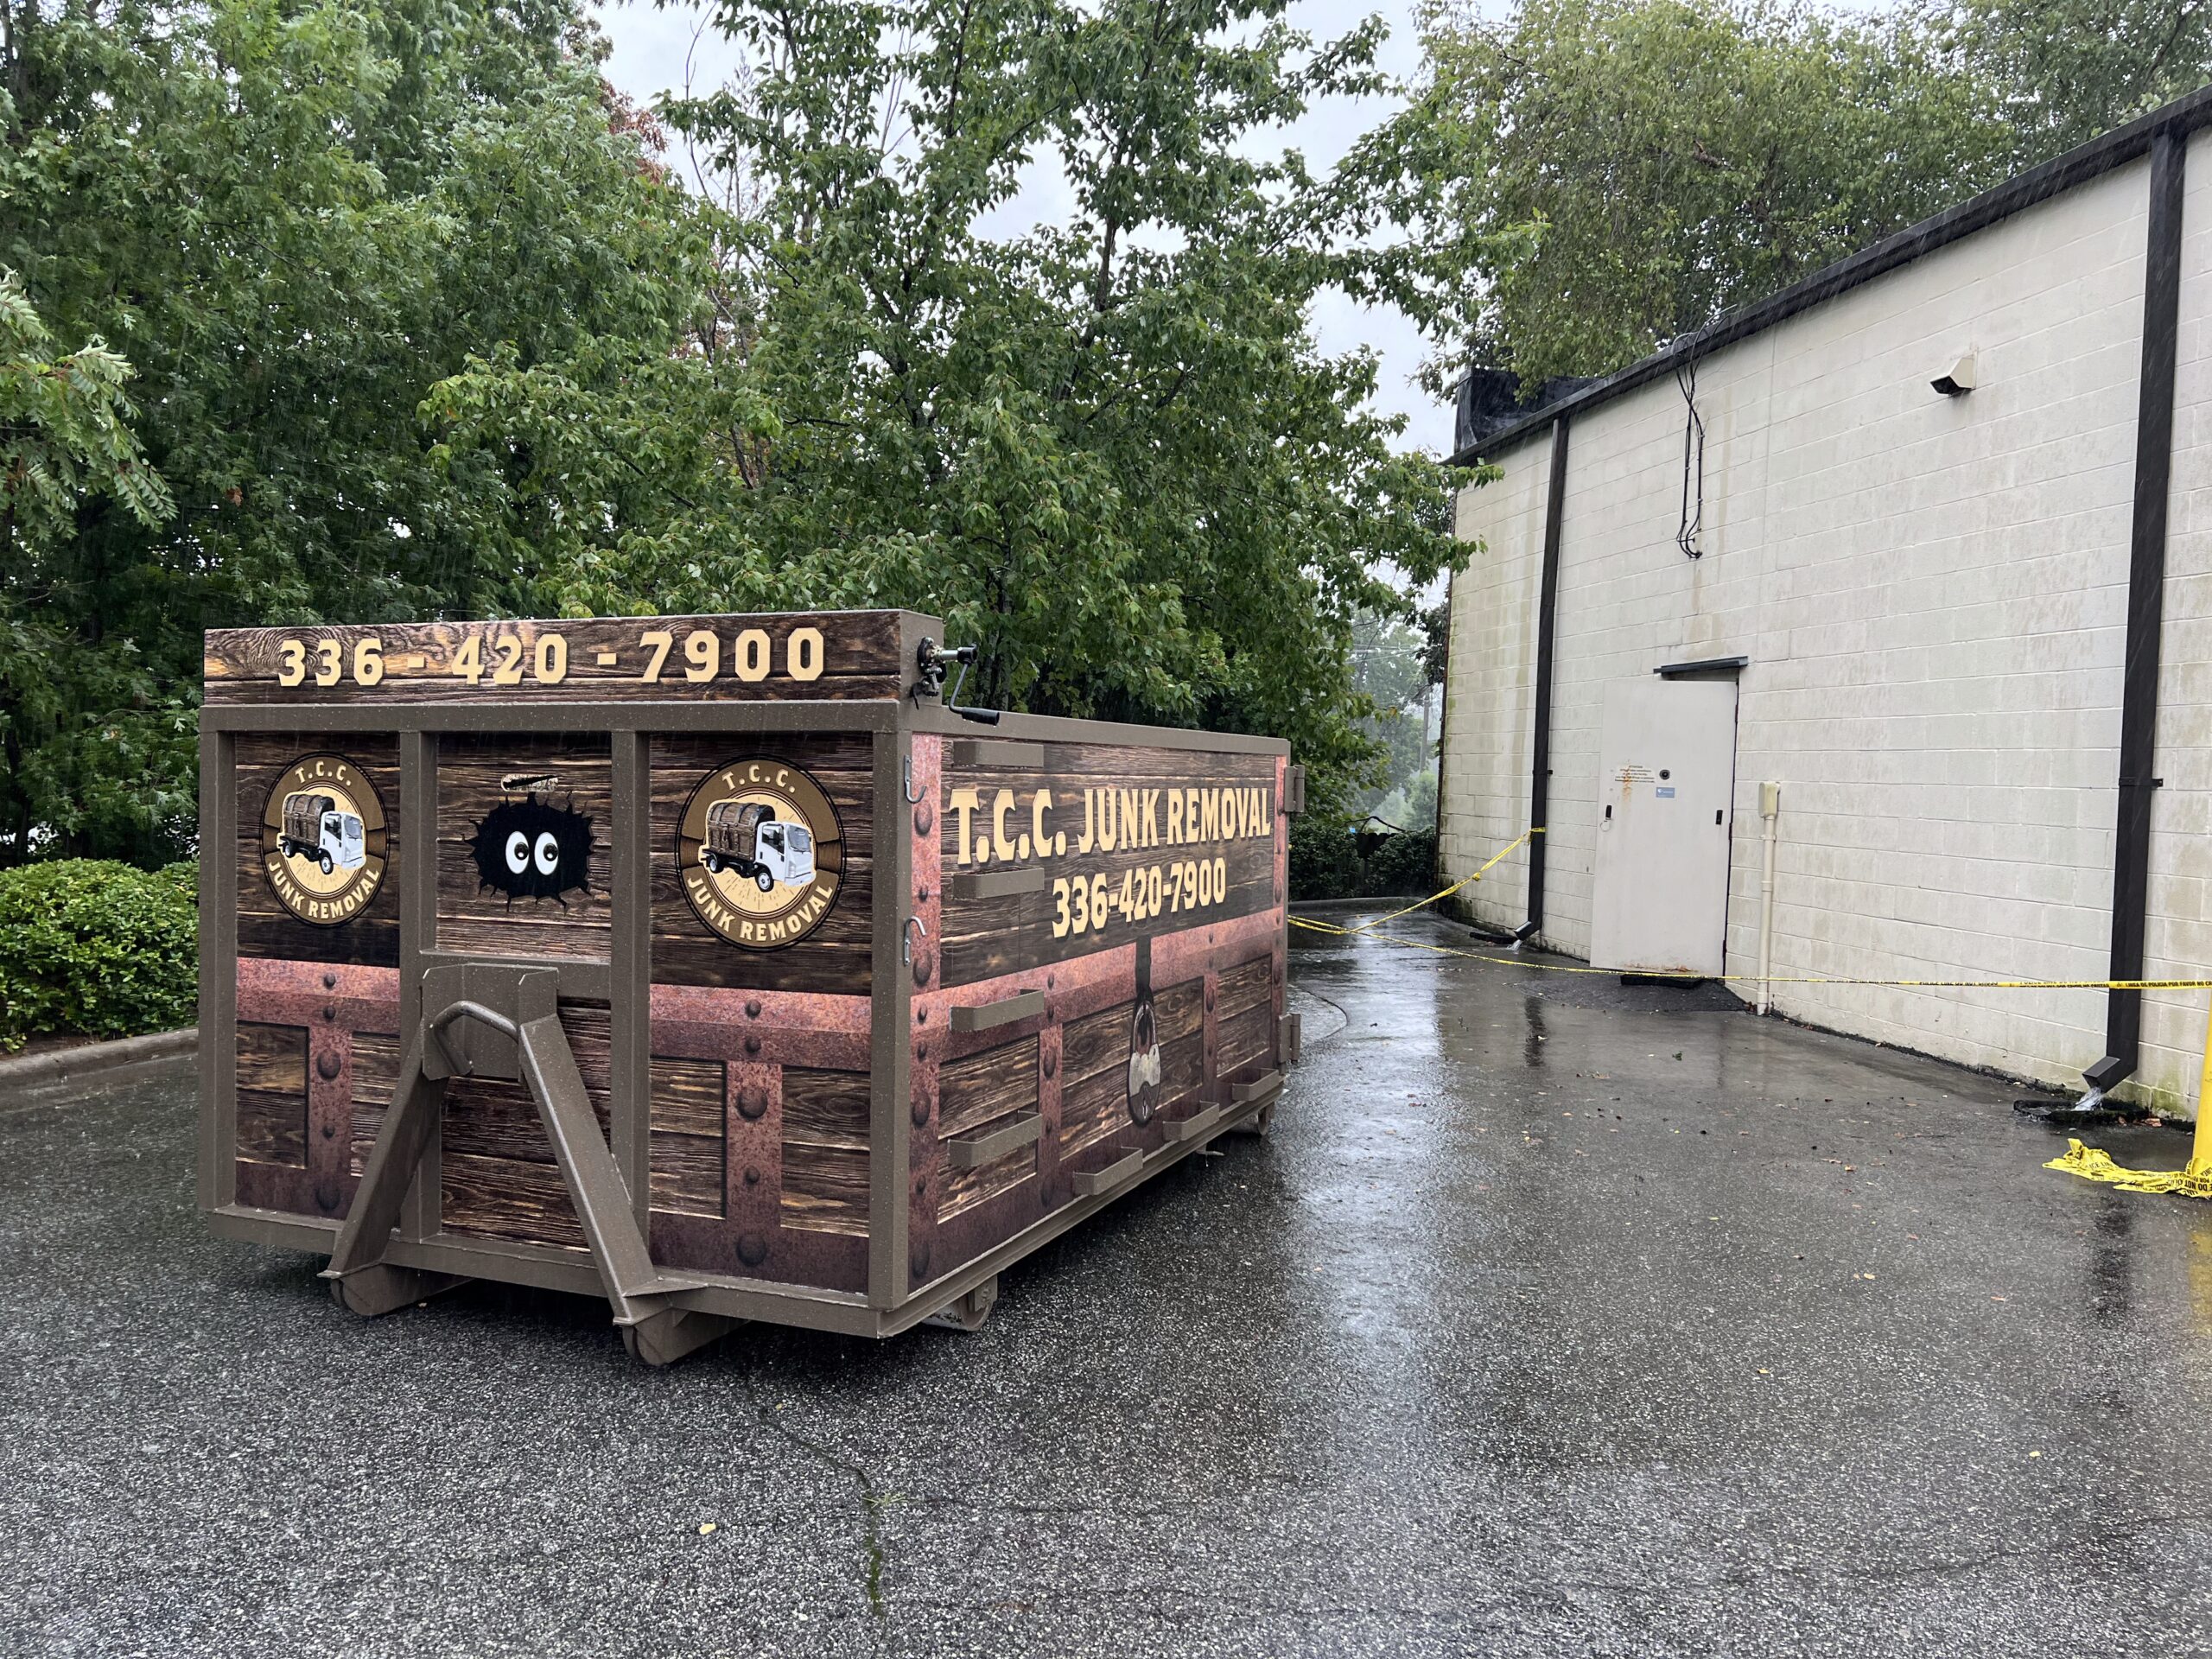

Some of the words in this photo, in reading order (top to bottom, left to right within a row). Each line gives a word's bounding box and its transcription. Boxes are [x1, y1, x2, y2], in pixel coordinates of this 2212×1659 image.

[278, 638, 383, 687] 336
[450, 634, 567, 685] 420
[639, 627, 824, 683] 7900
[295, 760, 352, 786] T.C.C.
[722, 764, 796, 792] T.C.C.
[949, 788, 1067, 865] T.C.C.
[1077, 788, 1160, 854] JUNK
[1166, 787, 1271, 845] REMOVAL
[268, 861, 305, 912] JUNK
[308, 868, 380, 919] REMOVAL
[687, 875, 735, 931] JUNK
[739, 884, 834, 942] REMOVAL
[1052, 857, 1226, 938] 336-420-7900
[2184, 1179, 2196, 1190] NOT
[2198, 1183, 2208, 1192] DO
